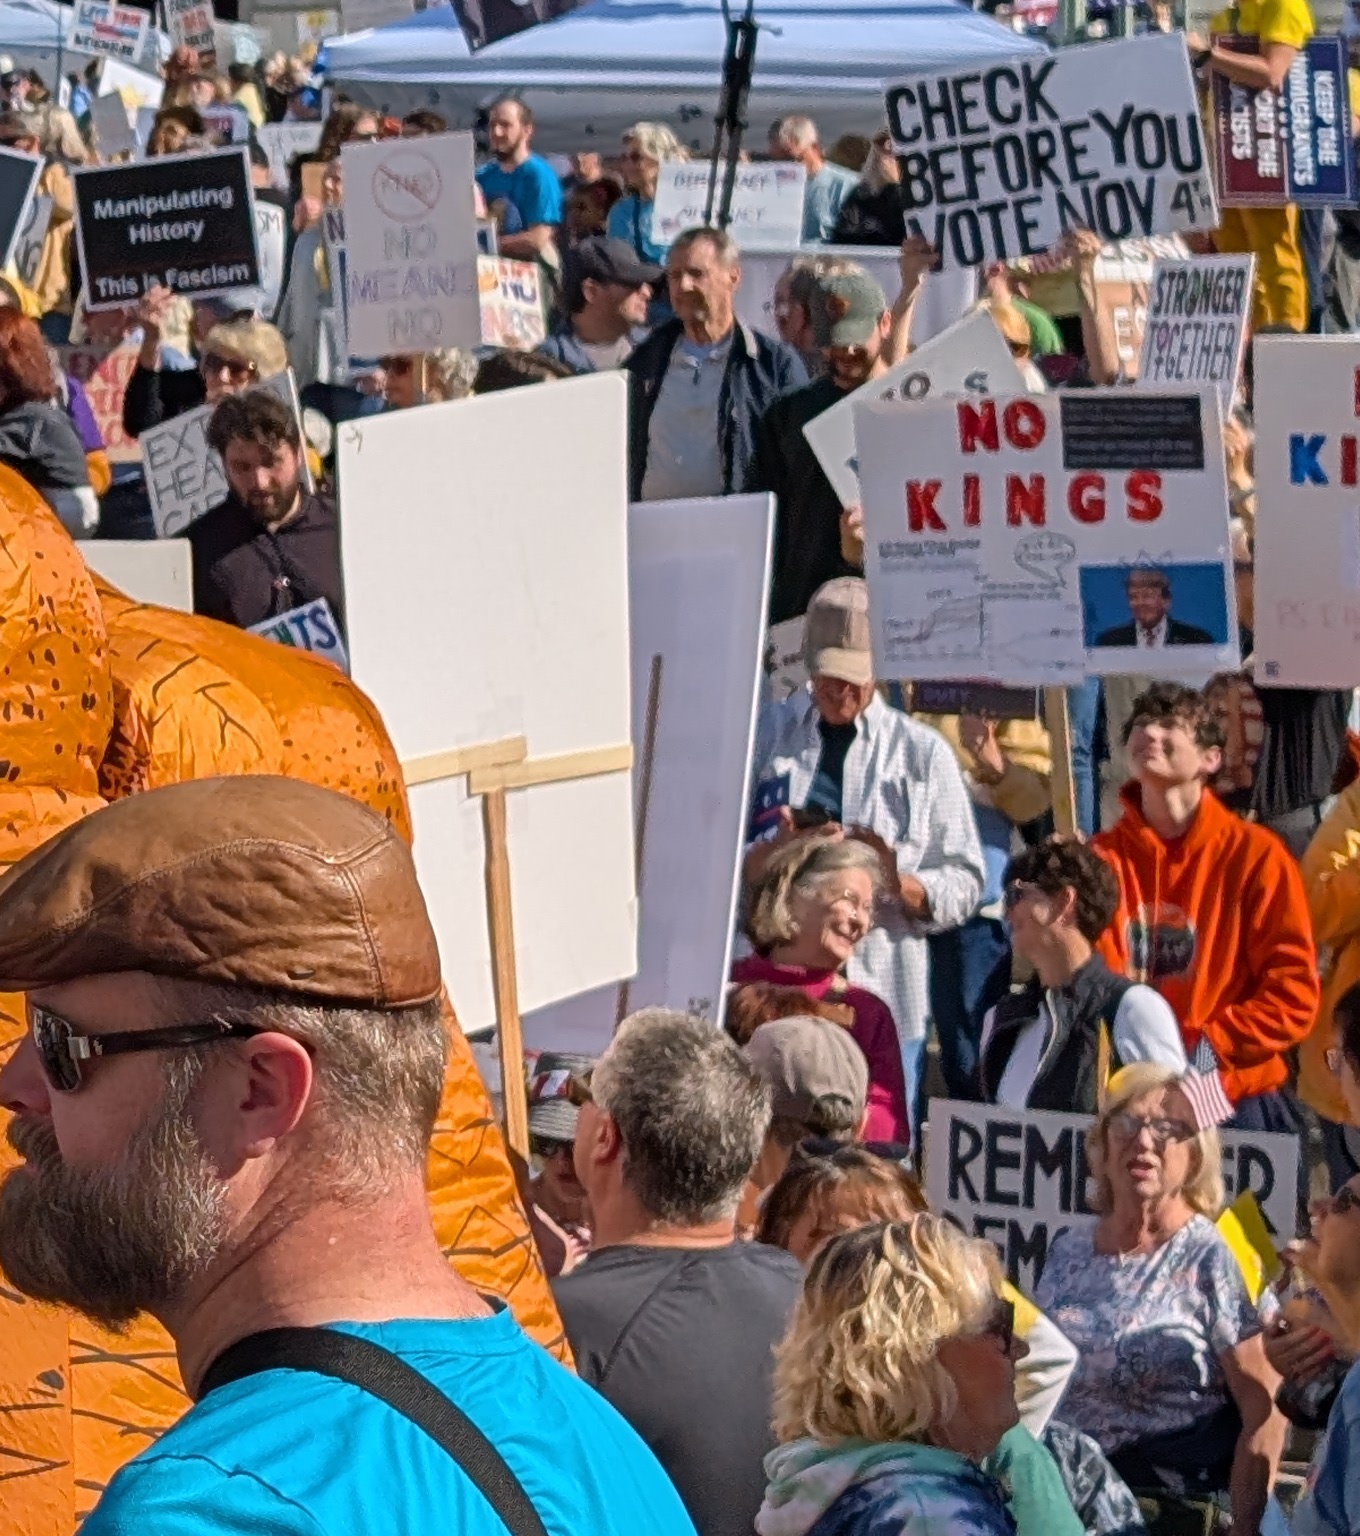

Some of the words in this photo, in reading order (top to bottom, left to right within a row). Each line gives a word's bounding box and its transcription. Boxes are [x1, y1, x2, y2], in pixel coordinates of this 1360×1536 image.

[884, 58, 1059, 144] CHECK
[1313, 70, 1336, 125] KEEP
[901, 119, 1101, 208] BEFORE
[1089, 103, 1203, 173] YOU
[1316, 127, 1340, 166] THE
[93, 186, 235, 220] Manipulating
[906, 195, 1051, 273] VOTE
[1057, 177, 1156, 241] NOV
[128, 219, 206, 246] History
[383, 224, 438, 260] NO
[94, 275, 140, 298] This
[164, 263, 250, 286] Fascism
[1153, 268, 1246, 317] STRONGER
[956, 399, 1047, 454] NO
[905, 469, 1164, 534] KINGS
